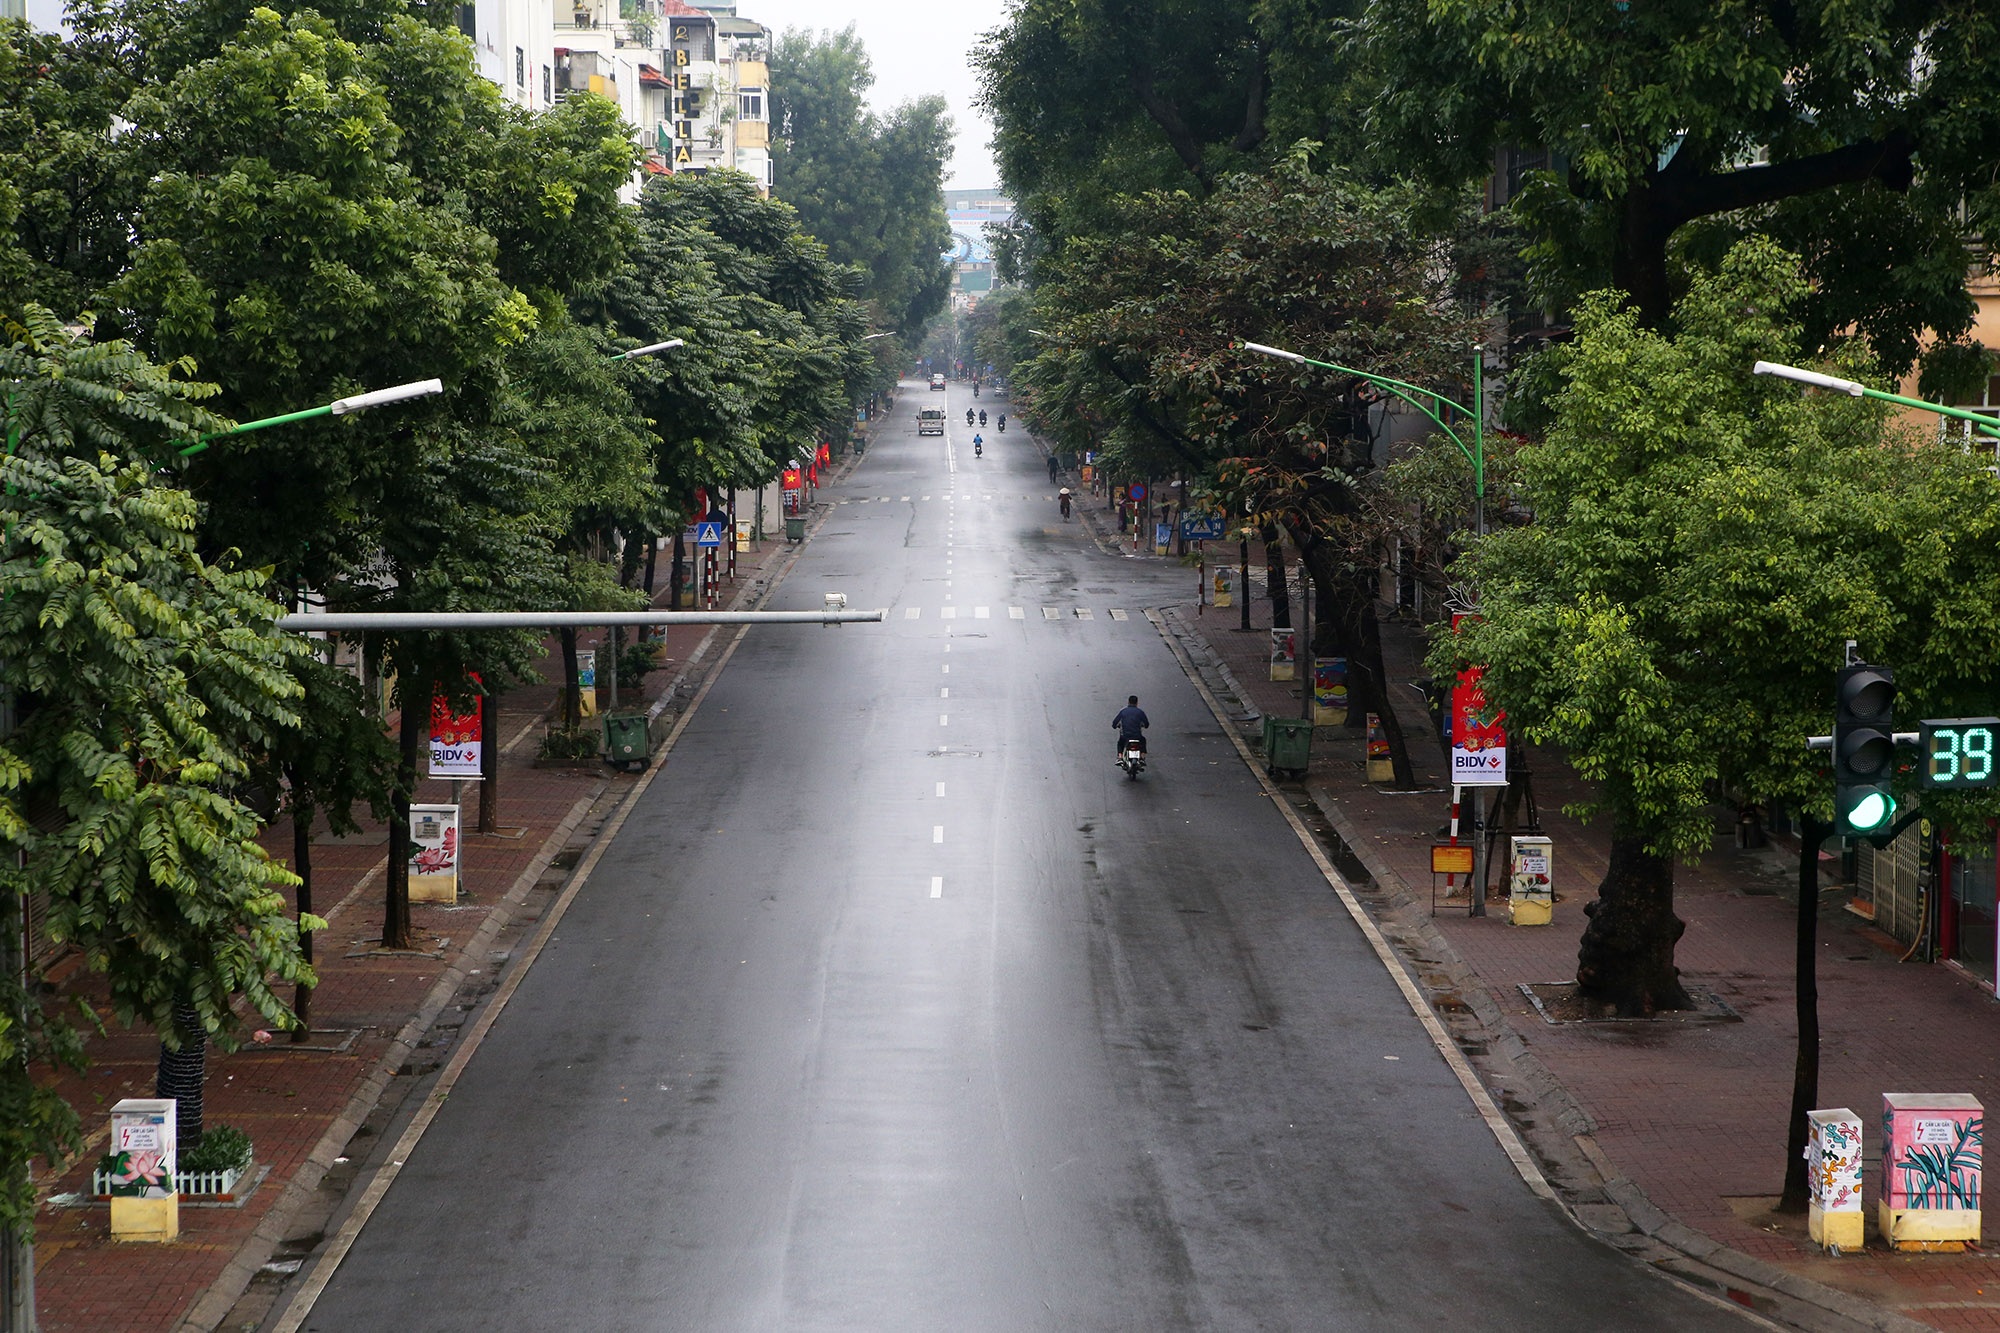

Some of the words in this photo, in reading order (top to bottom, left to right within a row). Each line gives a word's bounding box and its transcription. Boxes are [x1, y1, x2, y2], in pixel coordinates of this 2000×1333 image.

[676, 50, 692, 163] BELLA
[433, 749, 463, 761] BIDV
[1455, 756, 1487, 767] BIDV
[1932, 728, 1993, 781] 39
